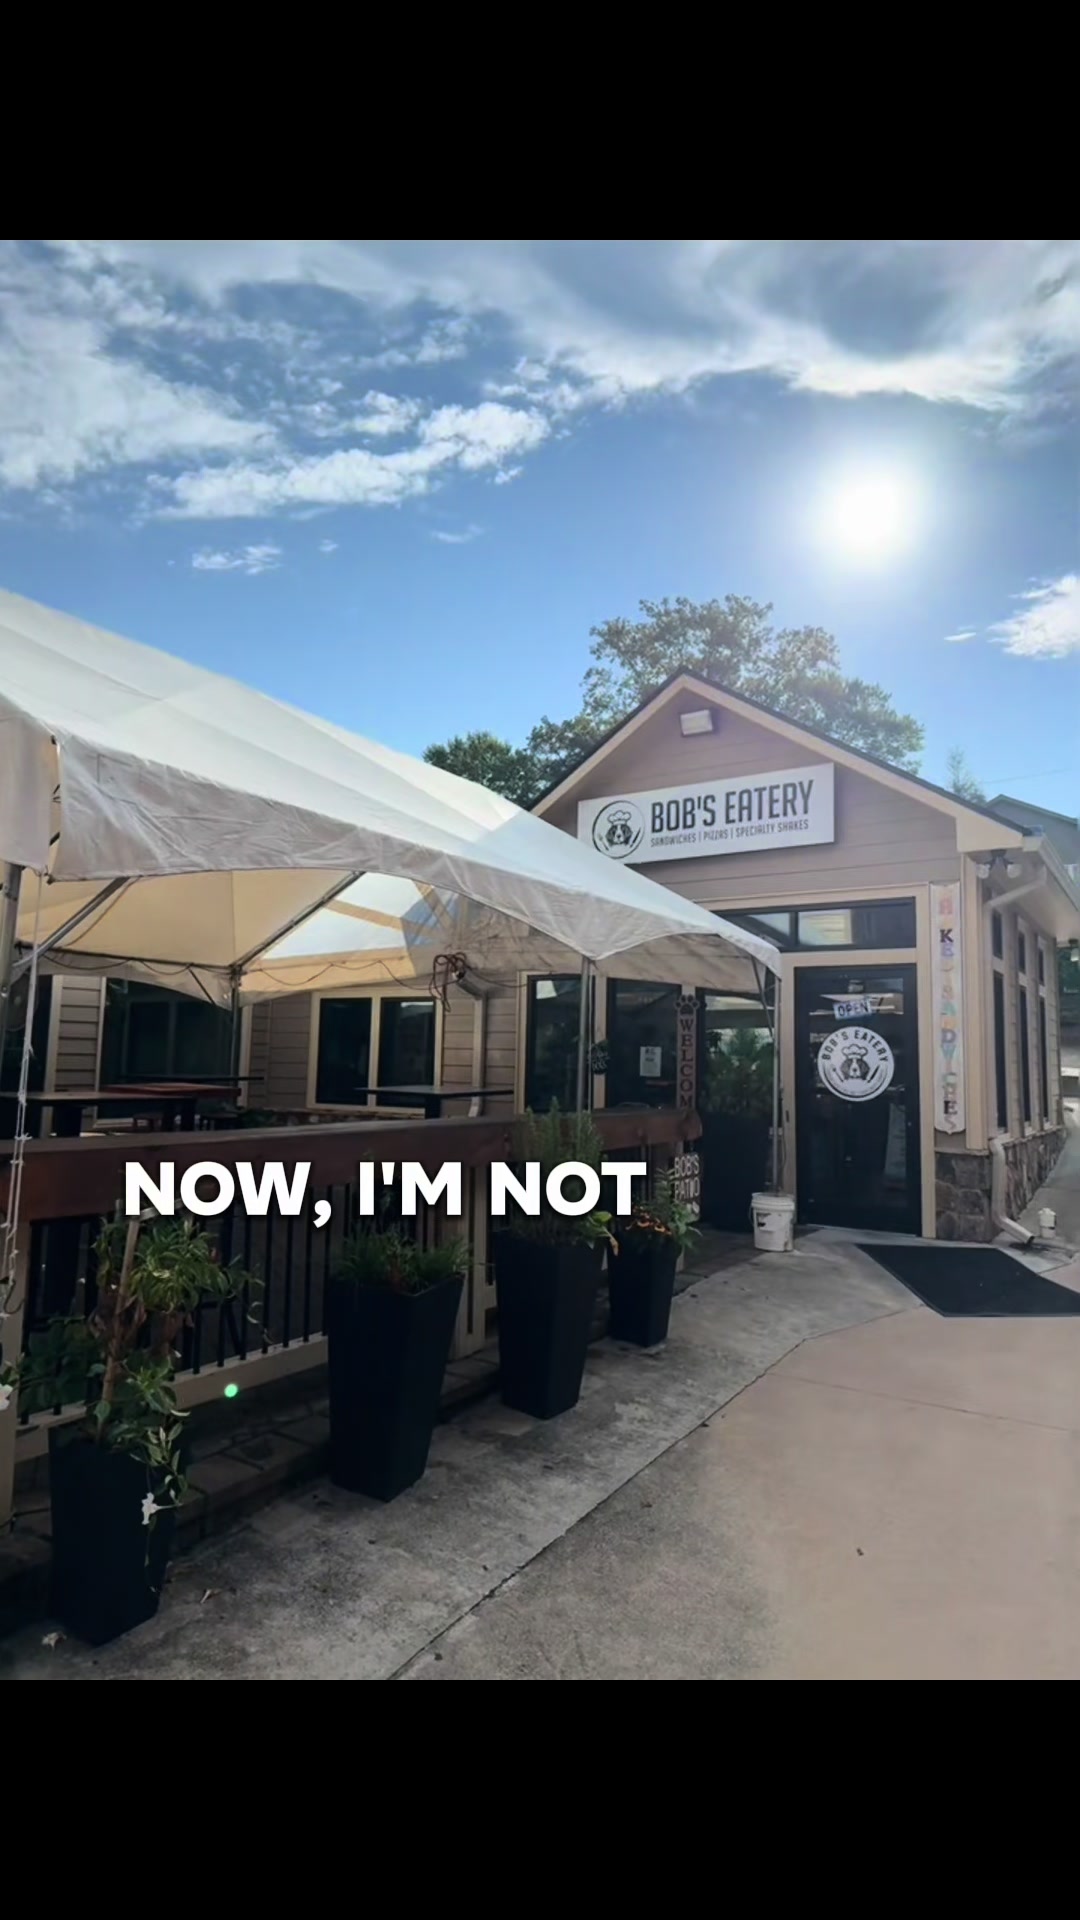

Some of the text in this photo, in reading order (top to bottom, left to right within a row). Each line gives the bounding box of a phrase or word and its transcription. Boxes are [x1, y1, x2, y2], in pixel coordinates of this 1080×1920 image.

[651, 779, 814, 833] BOB'S EATERY
[650, 819, 809, 848] SANDWICHES PIZZAS SPECIALTY SHAKES
[837, 1002, 869, 1017] OPEN
[821, 1029, 888, 1062] BOB'S EATERY
[680, 1018, 694, 1109] WELCOM
[674, 1154, 700, 1178] BOB'S
[674, 1177, 701, 1201] PATIO
